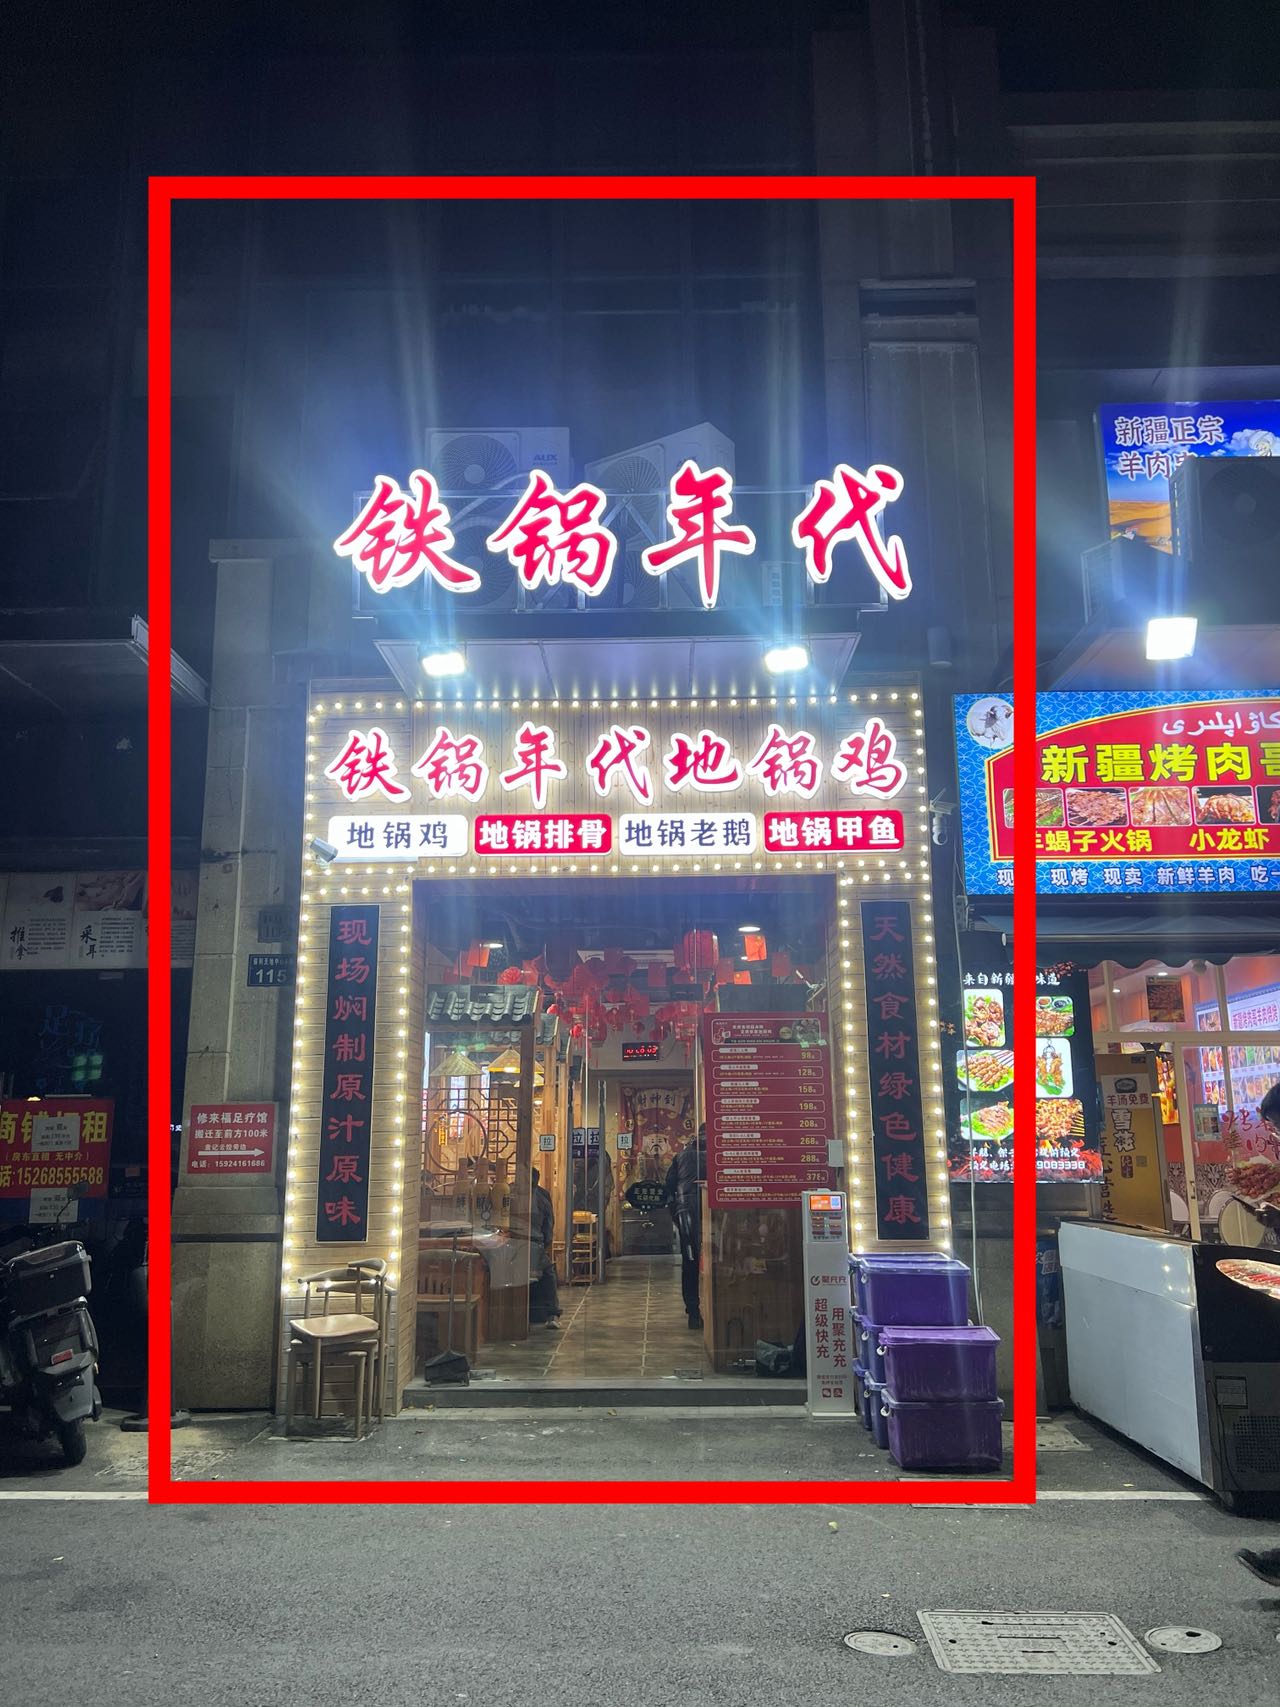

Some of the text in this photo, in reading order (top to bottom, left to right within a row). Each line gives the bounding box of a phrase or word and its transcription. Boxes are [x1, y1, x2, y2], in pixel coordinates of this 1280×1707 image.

[1114, 415, 1224, 446] 新疆正宗
[334, 460, 912, 608] 铁锅年代
[325, 718, 908, 808] 铁锅年代地锅鸡
[346, 819, 449, 850] 地锅鸡
[479, 816, 606, 851] 地锅排骨
[625, 813, 751, 847] 地锅老鹅
[768, 812, 900, 847] 地锅甲鱼
[1036, 828, 1269, 853] 蝎子火锅 小龙虾
[1050, 868, 1088, 886] 现烤
[1103, 867, 1143, 885] 现卖
[1157, 866, 1235, 885] 新鲜羊肉
[80, 925, 97, 959] 采耳
[256, 968, 287, 983] 115
[963, 972, 1060, 986] 来自新疆味道
[325, 919, 372, 1226] 现场焖制原汁原味
[870, 916, 920, 1224] 天然食材绿色健康
[1107, 1093, 1150, 1106] 羊汤免费
[197, 1111, 268, 1124] 修来福足疗馆
[1112, 1109, 1135, 1152] 雪花
[814, 1298, 830, 1359] 超级快充
[832, 1307, 847, 1368] 用聚充充
